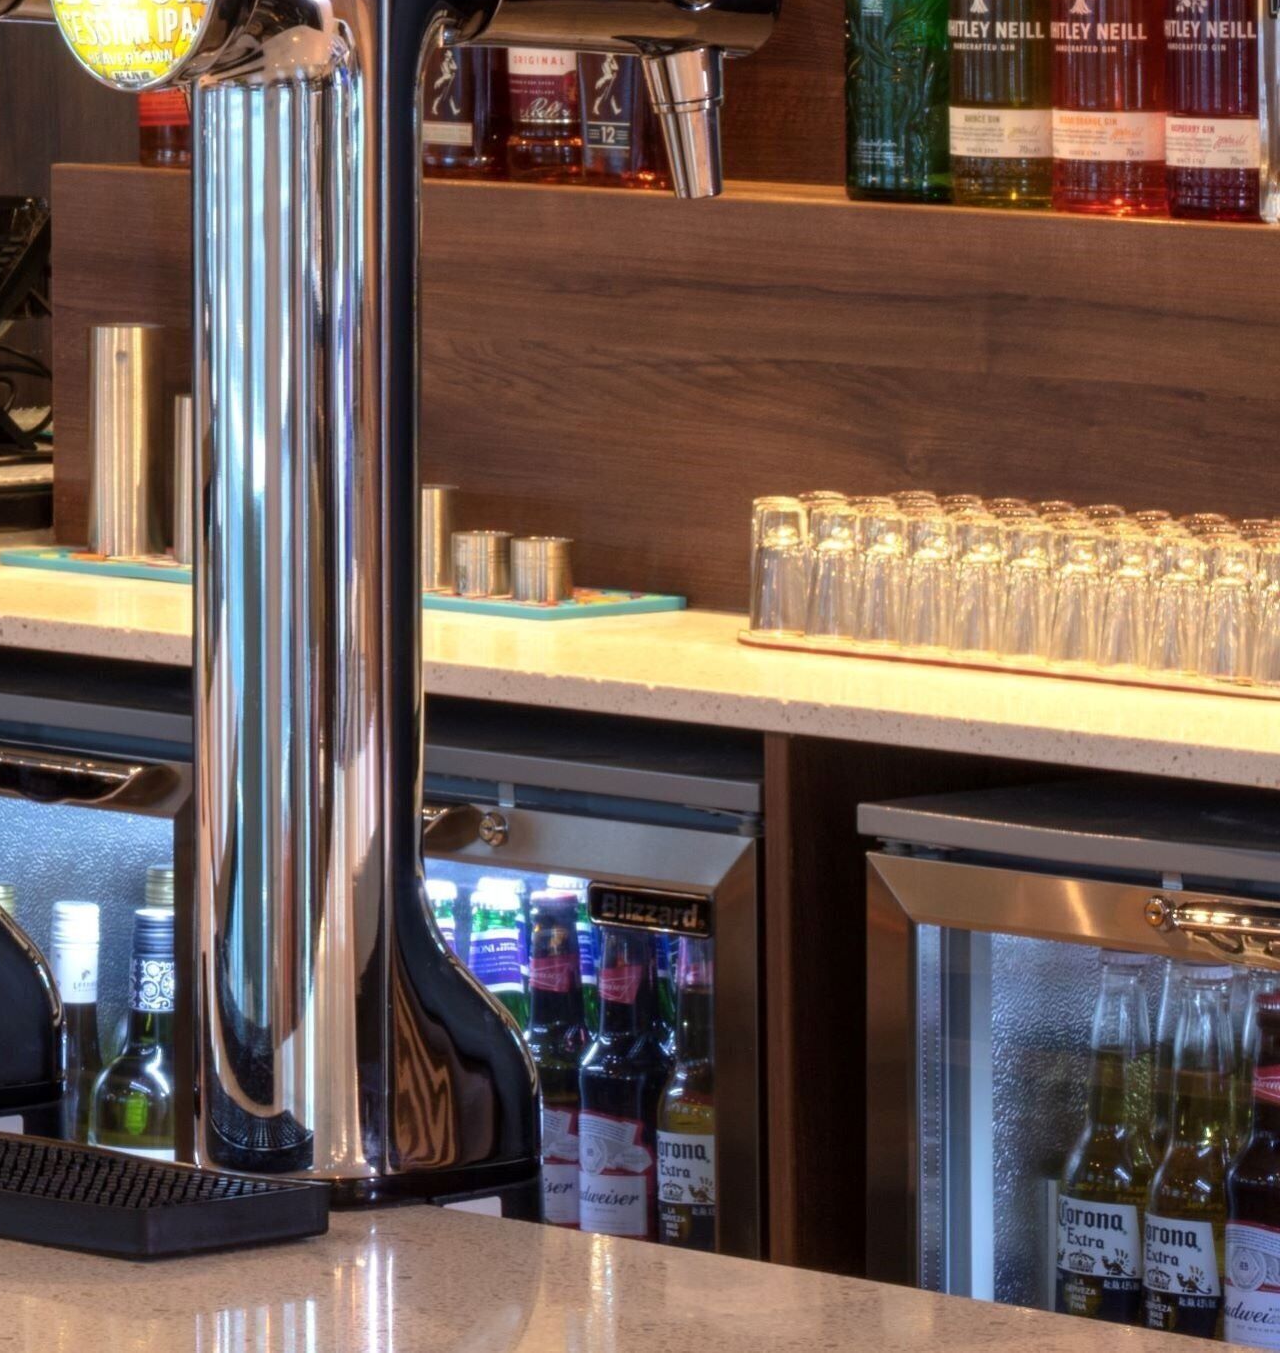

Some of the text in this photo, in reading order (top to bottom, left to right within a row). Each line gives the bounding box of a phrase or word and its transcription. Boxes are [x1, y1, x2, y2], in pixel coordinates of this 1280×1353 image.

[61, 5, 200, 45] SESSION IPA
[948, 20, 1045, 39] HITLEY NEILL
[1050, 22, 1147, 40] HITLEY NEILL
[1207, 21, 1257, 39] NEILL
[1001, 43, 1016, 52] GIN
[1102, 45, 1117, 54] GIN
[1211, 43, 1227, 52] GIN
[513, 54, 566, 65] ORIGINAL
[601, 126, 616, 144] 12
[657, 1141, 706, 1159] orona
[660, 1159, 690, 1178] Extra
[583, 1186, 639, 1206] dweiser
[1059, 1200, 1123, 1230] Corona
[1067, 1227, 1105, 1249] Extra
[1145, 1223, 1197, 1248] orona
[1146, 1244, 1180, 1266] Extra
